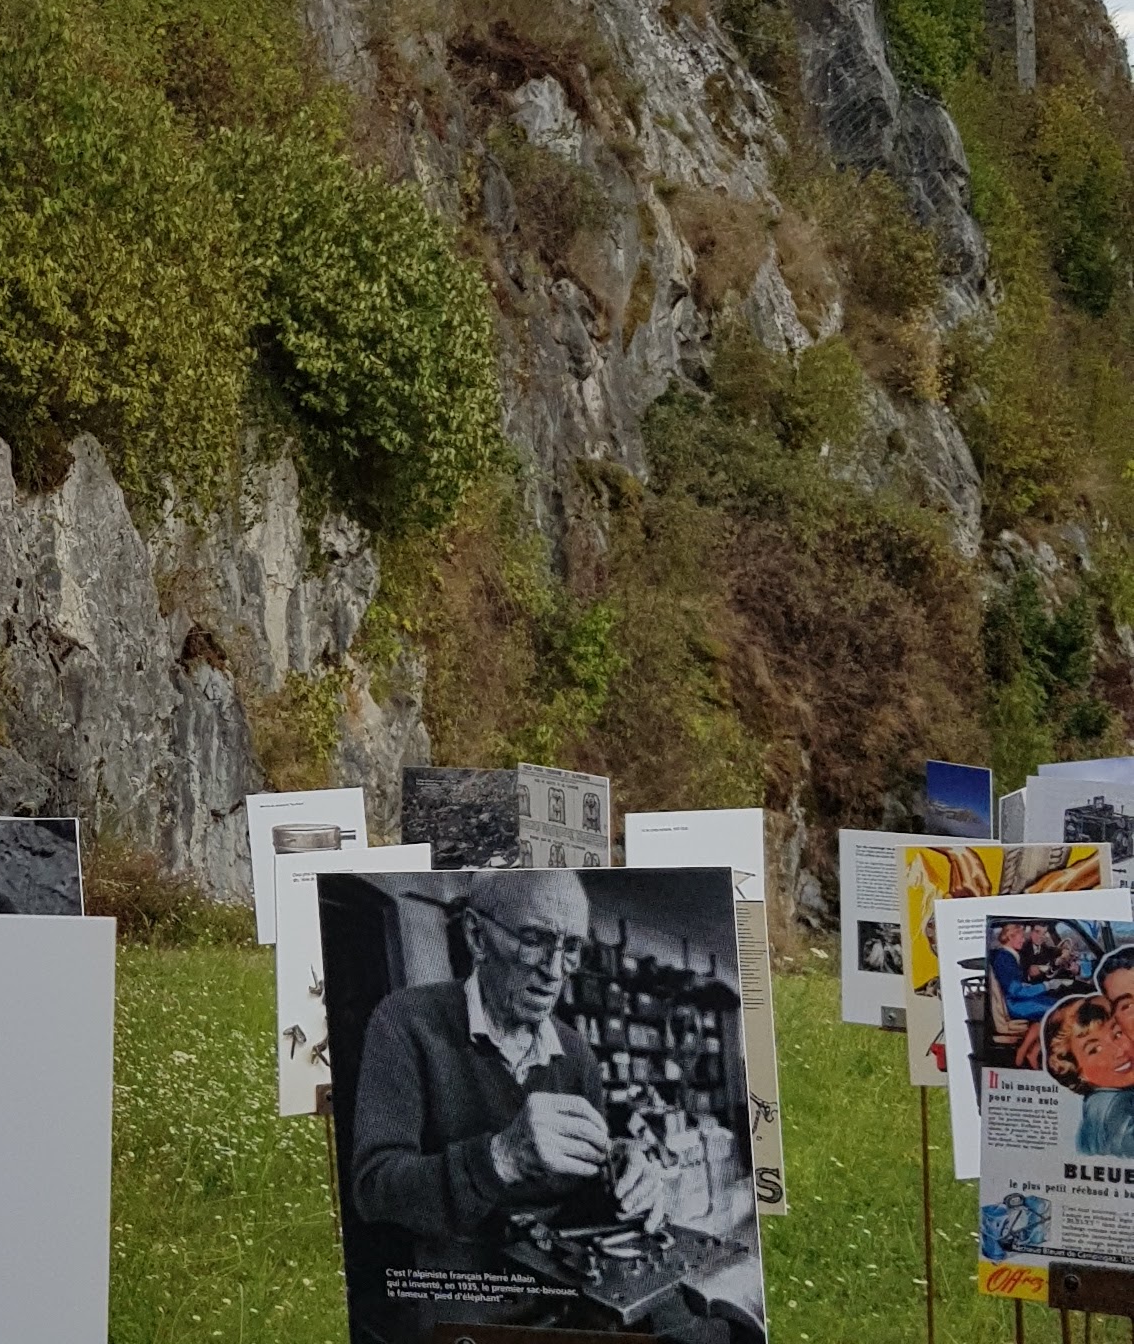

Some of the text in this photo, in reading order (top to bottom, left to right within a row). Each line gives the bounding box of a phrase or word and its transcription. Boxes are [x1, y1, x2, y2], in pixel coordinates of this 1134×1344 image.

[1009, 1179, 1018, 1188] le
[1022, 1180, 1041, 1192] plus
[1046, 1183, 1067, 1194] petit
[450, 1270, 482, 1282] français
[484, 1273, 509, 1282] Pierre
[386, 1279, 400, 1288] qui
[482, 1282, 490, 1291] le
[491, 1285, 524, 1293] premier
[387, 1288, 395, 1297] le
